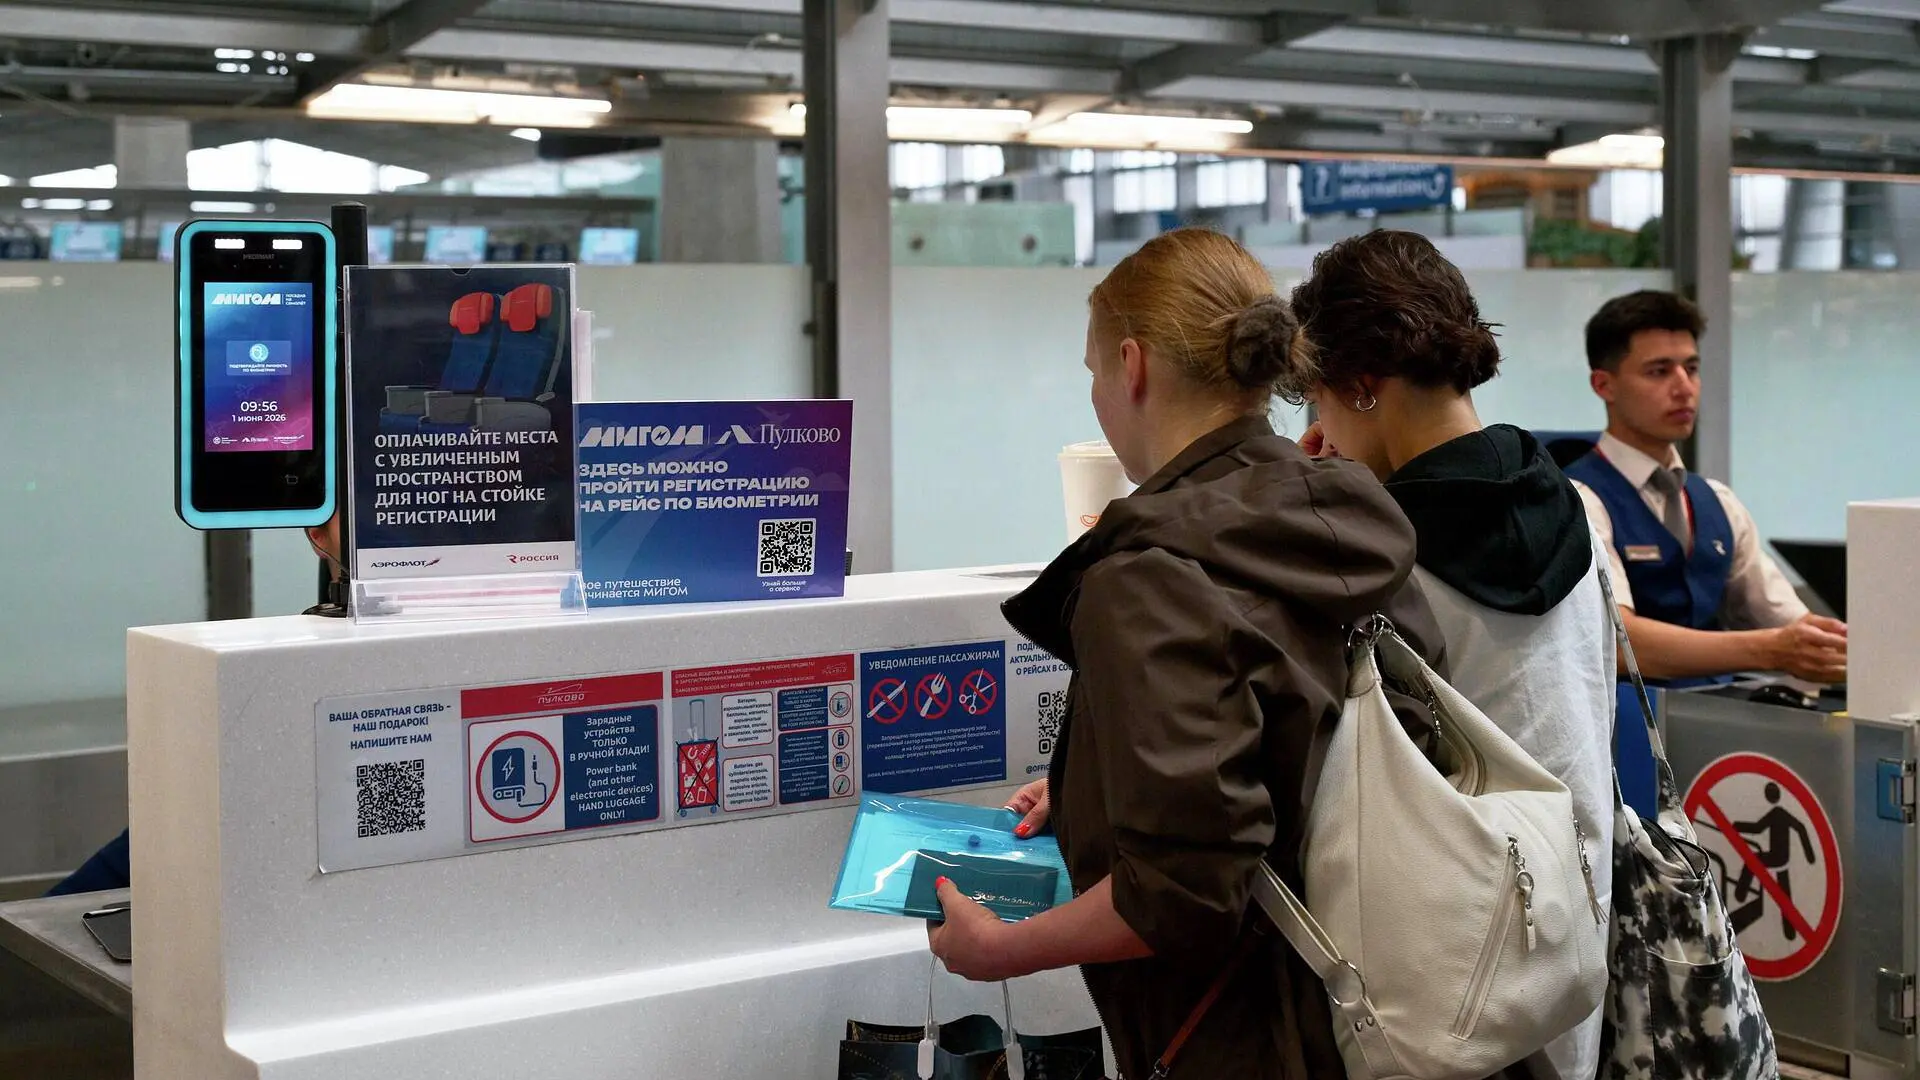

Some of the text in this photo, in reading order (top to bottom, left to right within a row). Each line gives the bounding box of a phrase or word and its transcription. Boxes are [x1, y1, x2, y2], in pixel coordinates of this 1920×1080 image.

[211, 293, 280, 305] МИГОМ
[241, 401, 277, 412] 09:56
[374, 429, 558, 448] ОПЛАЧИВАЙТЕ МЕСТА
[579, 425, 704, 448] МИГОМ
[760, 424, 840, 449] Пулково
[375, 450, 520, 467] С УВЕЛИЧЕННЫМ
[580, 460, 728, 478] ЗДЕСЬ МОЖНО
[376, 470, 522, 486] ПРОСТРАНСТВОМ
[580, 476, 810, 494] ПРОЙТИ РЕГИСТРАЦИЮ
[375, 486, 545, 508] ДЛЯ НОГ НА СТОЙКЕ
[580, 494, 819, 512] НА РЕЙС ПО БИОМЕТРИИ
[376, 508, 496, 525] РЕГИСТРАЦИИ
[371, 560, 426, 568] АЭРОФЛОТ
[583, 578, 680, 591] вое путешествие
[644, 587, 688, 596] МИГОМ
[869, 650, 1000, 671] УВЕДОМЛЕНИЕ ПАССАЖИРАМ
[1010, 653, 1053, 664] АКТУАЛЬНУ
[1023, 665, 1050, 675] РЕЙСАХ
[329, 712, 358, 722] ВАША
[361, 706, 411, 720] ОБРАТНАЯ
[414, 704, 444, 714] СВЯЗЬ
[353, 717, 429, 732] НАШ ПОДАРОК!
[587, 715, 632, 727] Зарядные
[584, 726, 635, 739] устройства
[350, 734, 432, 750] НАПИШИТЕ НАМ
[592, 737, 628, 748] ТОЛЬКО
[570, 745, 650, 762] В РУЧНОЙ КЛАДИ!
[586, 762, 637, 776] Power bank
[1026, 764, 1050, 774] @OFFIC
[588, 775, 636, 789] (and other
[570, 784, 653, 801] electronic devices)
[578, 796, 646, 811] HAND LUGGAGE
[600, 810, 625, 821] ONLY!
